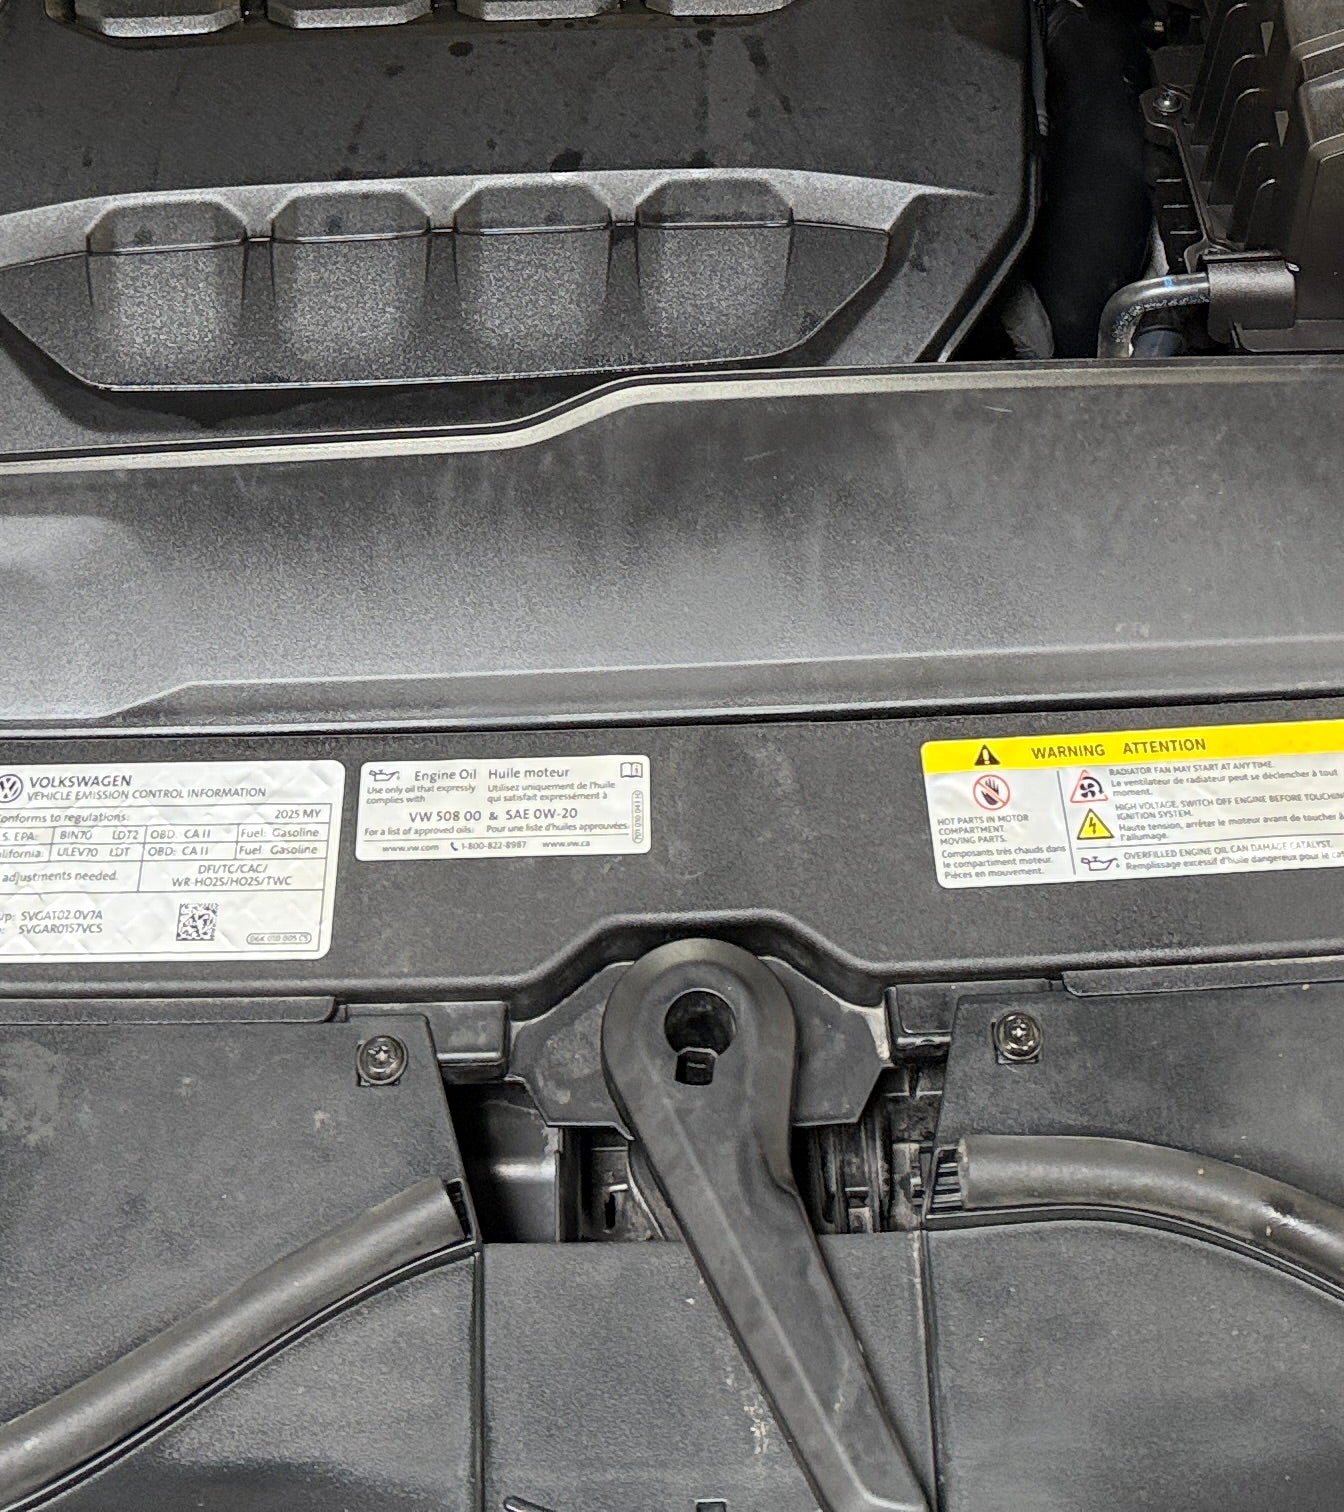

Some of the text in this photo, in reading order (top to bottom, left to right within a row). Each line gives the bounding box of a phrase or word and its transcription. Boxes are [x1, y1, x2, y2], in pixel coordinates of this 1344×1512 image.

[1031, 738, 1207, 759] WARNING ATTENTION
[488, 767, 570, 780] Huile moteur
[1109, 761, 1250, 776] RADIATOR FAN MAY START AT ANY
[29, 775, 132, 788] VOLKSWAGEN
[415, 768, 477, 784] Engine Oil
[1111, 779, 1122, 788] Le
[1124, 778, 1171, 787] ventilateur
[1173, 776, 1185, 785] de
[1186, 775, 1226, 784] radiateur
[1228, 773, 1249, 783] peut
[1250, 773, 1260, 781] se
[1319, 768, 1338, 777] tout
[366, 782, 477, 796] Use only oil that expressly
[487, 783, 520, 793] Utilisez
[521, 781, 575, 793] uniquement
[576, 780, 588, 790] de
[27, 787, 267, 801] VEHICLE EMISSION CONTROL INFORMATION
[487, 794, 502, 804] qui
[503, 792, 538, 802] satisfait
[539, 791, 600, 803] expressément
[1113, 789, 1153, 797] moment.
[366, 795, 426, 806] complies with
[1115, 801, 1138, 811] HIGH
[1180, 799, 1214, 808] SWITCH
[1215, 797, 1233, 806] OFF
[1235, 794, 1267, 805] ENGINE
[1268, 793, 1303, 803] BEFORE
[50, 814, 61, 823] to
[274, 809, 322, 819] 2025 MY
[409, 807, 578, 823] VW 508 00 & SAE 0W-20
[937, 814, 1030, 826] HOT PARTS IN MOTOR
[1117, 810, 1157, 821] IGNITION
[486, 824, 506, 833] Pour
[507, 824, 524, 833] une
[525, 822, 544, 832] liste
[1119, 823, 1146, 832] Haute
[1185, 819, 1216, 829] arrêter
[1218, 818, 1226, 826] le
[1228, 817, 1260, 825] moteur
[1263, 815, 1288, 824] avant
[1290, 814, 1302, 822] de
[1303, 813, 1337, 822] toucher
[59, 829, 139, 841] BIN70 LDT2
[183, 829, 200, 839] CA
[272, 827, 320, 838] Gasoline
[364, 825, 455, 837] For a list of approved
[461, 841, 527, 850] 1-800-822-8987
[542, 840, 591, 848] www.vw.ca
[940, 836, 976, 846] MOVING
[56, 847, 131, 857] ULEV70 LDT
[147, 846, 199, 856] OBD: CA
[270, 845, 318, 855] Gasoline
[382, 844, 440, 852] www.vw.com
[942, 849, 994, 859] Composants
[1014, 845, 1044, 854] chauds
[1045, 844, 1067, 853] dans
[1124, 849, 1177, 860] OVERFILLED
[1179, 847, 1213, 857] ENGINE
[1214, 846, 1229, 855] OIL
[1230, 844, 1249, 853] CAN
[1251, 841, 1288, 851] DAMAGE
[943, 858, 1018, 870] le compartiment
[1126, 860, 1182, 871] Remplissage
[1183, 857, 1218, 868] excessif
[1251, 854, 1298, 864] dangereux
[1299, 852, 1319, 862] pour
[1321, 851, 1330, 860] le
[2, 871, 72, 885] adjustments
[974, 870, 986, 878] en
